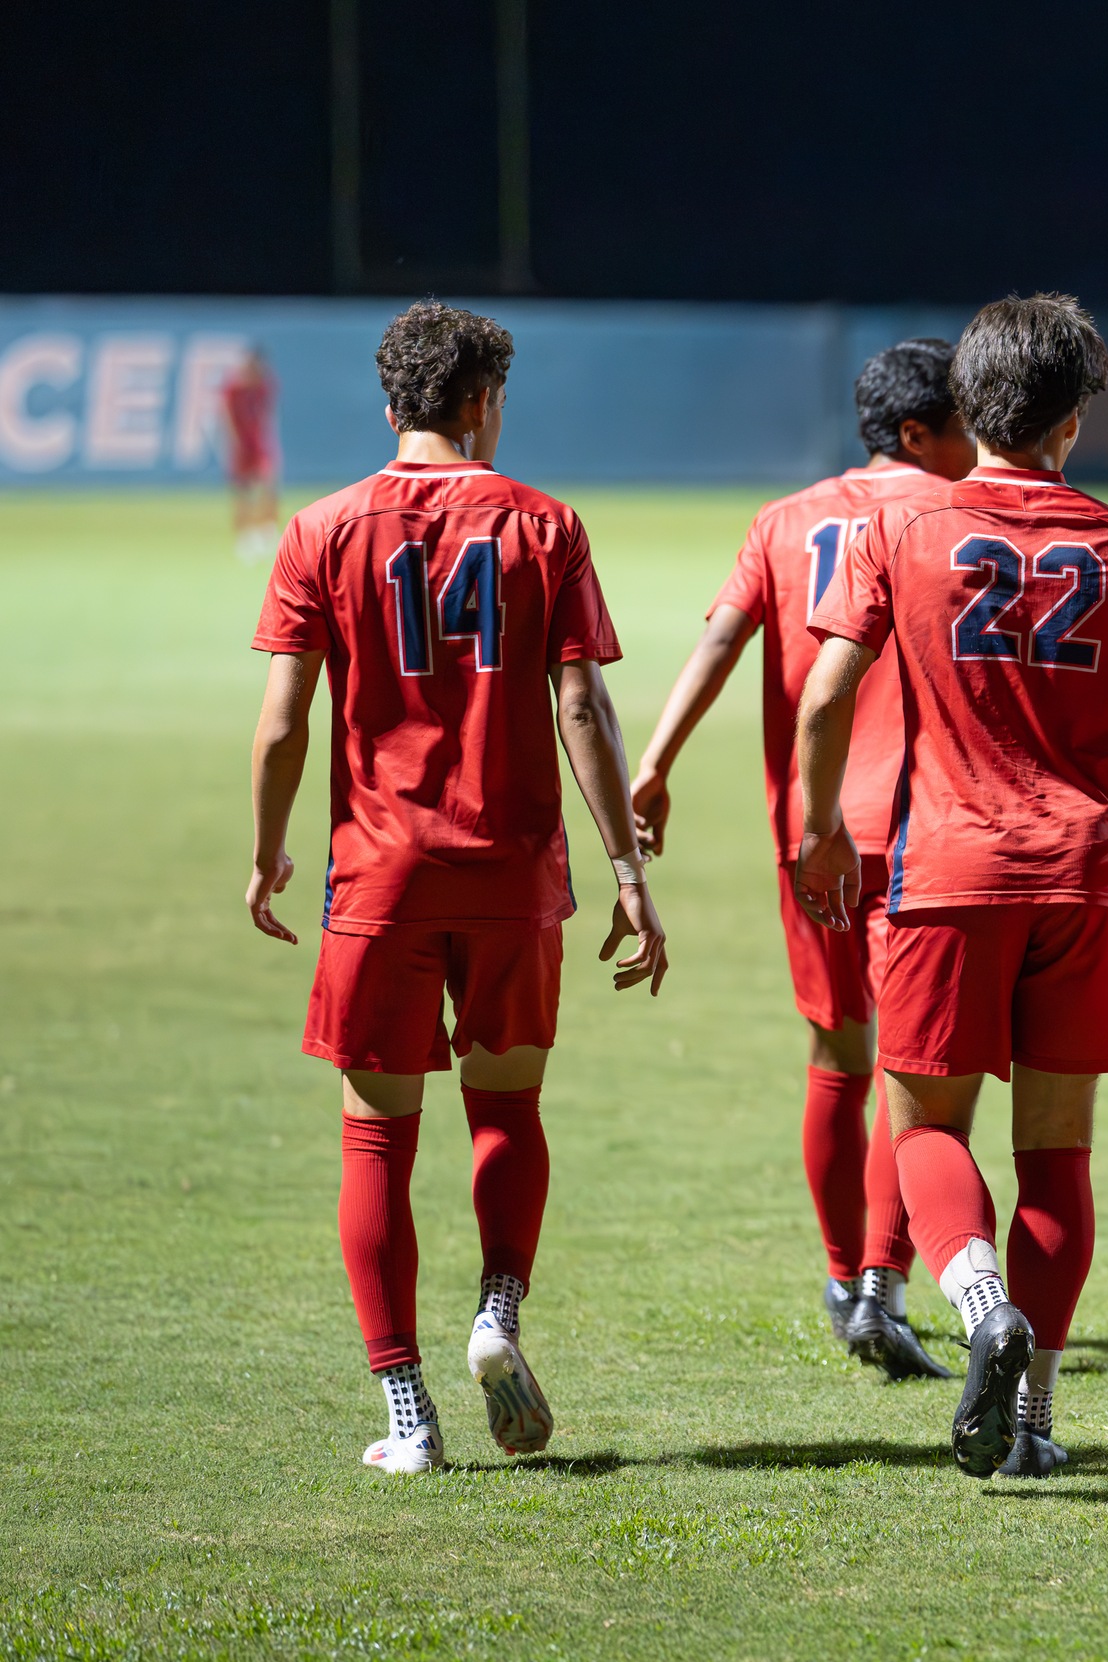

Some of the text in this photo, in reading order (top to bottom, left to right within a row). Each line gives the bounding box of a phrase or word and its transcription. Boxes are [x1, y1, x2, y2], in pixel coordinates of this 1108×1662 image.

[385, 536, 506, 676] 14
[805, 517, 871, 625] 1
[949, 532, 1107, 673] 22
